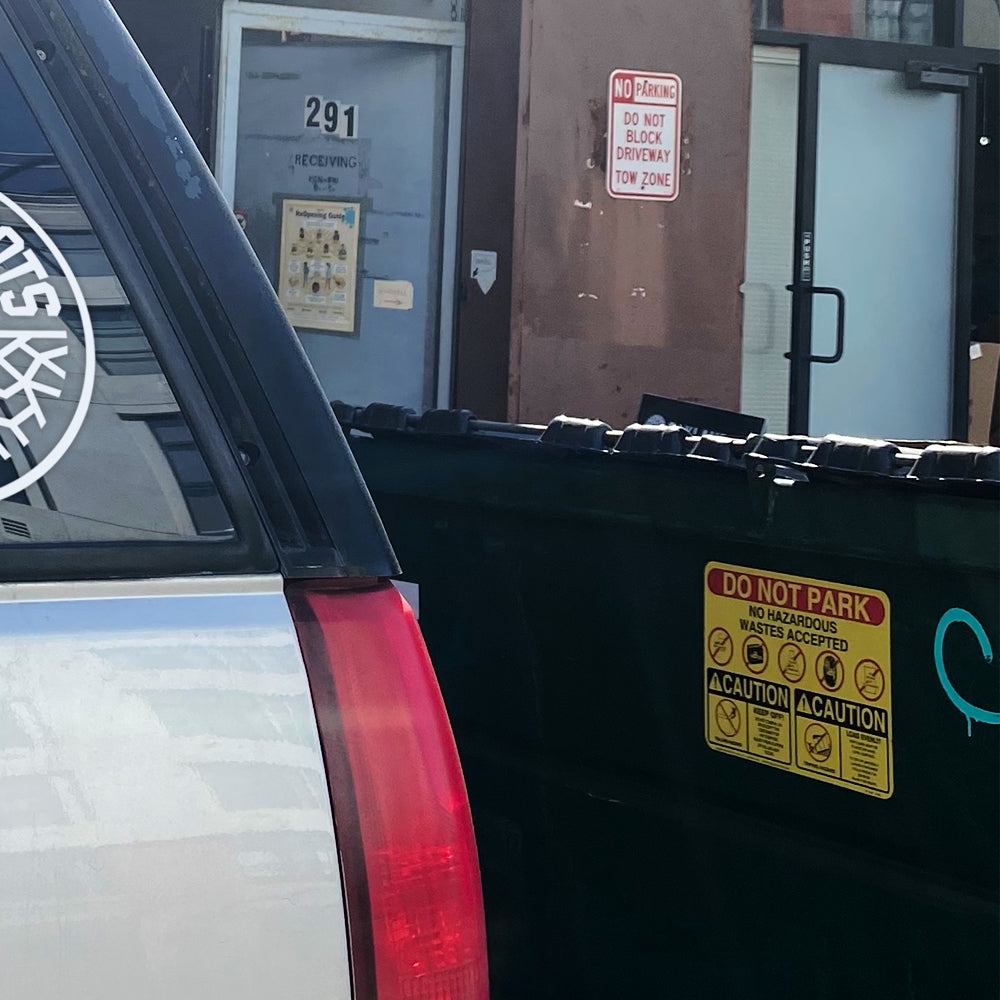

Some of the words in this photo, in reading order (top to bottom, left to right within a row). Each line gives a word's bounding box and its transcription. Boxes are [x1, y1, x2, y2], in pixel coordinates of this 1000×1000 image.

[614, 78, 633, 98] NO
[636, 81, 675, 99] PARKING
[306, 96, 355, 137] 291
[624, 111, 639, 126] DO
[644, 113, 665, 127] NOT
[626, 129, 662, 145] BLOCK
[295, 153, 358, 169] RECEIVING
[616, 146, 671, 162] DRIVEWAY
[615, 170, 638, 185] TOW
[642, 171, 672, 187] ZONE
[721, 571, 752, 600] DO
[757, 578, 802, 608] NOT
[807, 588, 870, 622] PARK
[749, 605, 764, 619] NO
[767, 609, 838, 634] HAZARDOUS
[739, 618, 785, 640] WASTES
[786, 628, 848, 652] ACCEPTED
[721, 675, 789, 710] CAUTION
[811, 695, 886, 734] CAUTION
